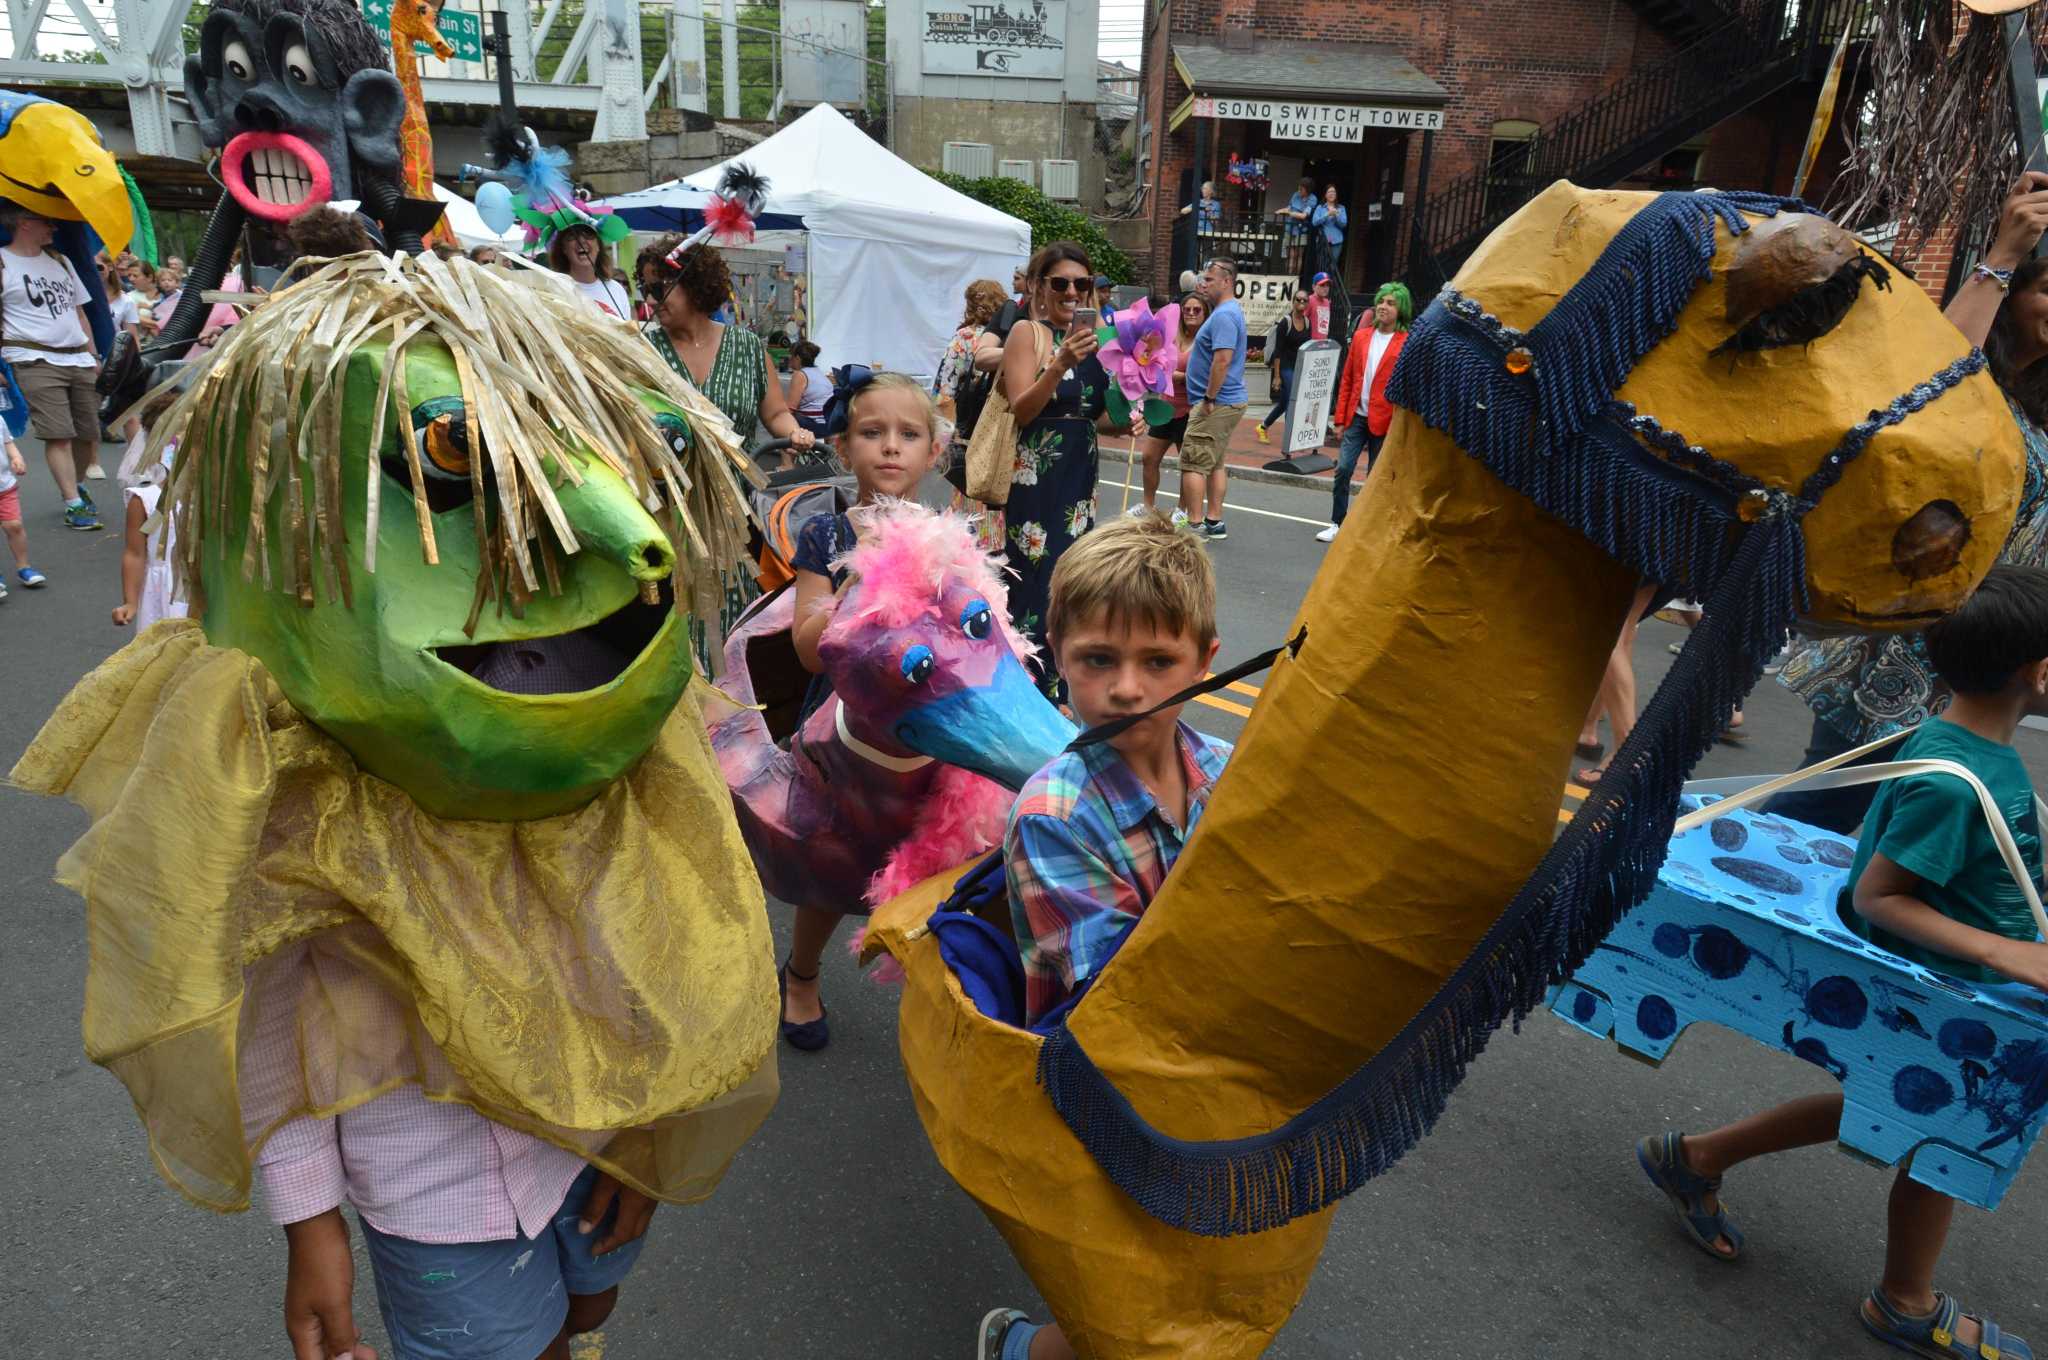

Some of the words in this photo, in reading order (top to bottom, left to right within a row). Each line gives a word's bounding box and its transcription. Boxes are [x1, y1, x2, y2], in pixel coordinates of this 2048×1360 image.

[439, 15, 459, 32] ain
[463, 17, 476, 35] St
[447, 37, 461, 54] St
[1218, 102, 1271, 117] SONO
[1281, 105, 1360, 123] SWITCH
[1370, 110, 1438, 127] TOWER
[1276, 123, 1358, 140] MUSEUM
[1234, 280, 1293, 301] OPEN
[1313, 357, 1330, 368] SONO
[1308, 368, 1331, 379] SWITCH
[1309, 379, 1328, 389] TOWER
[1304, 389, 1328, 401] MUSEUM
[1298, 429, 1320, 442] OPEN
